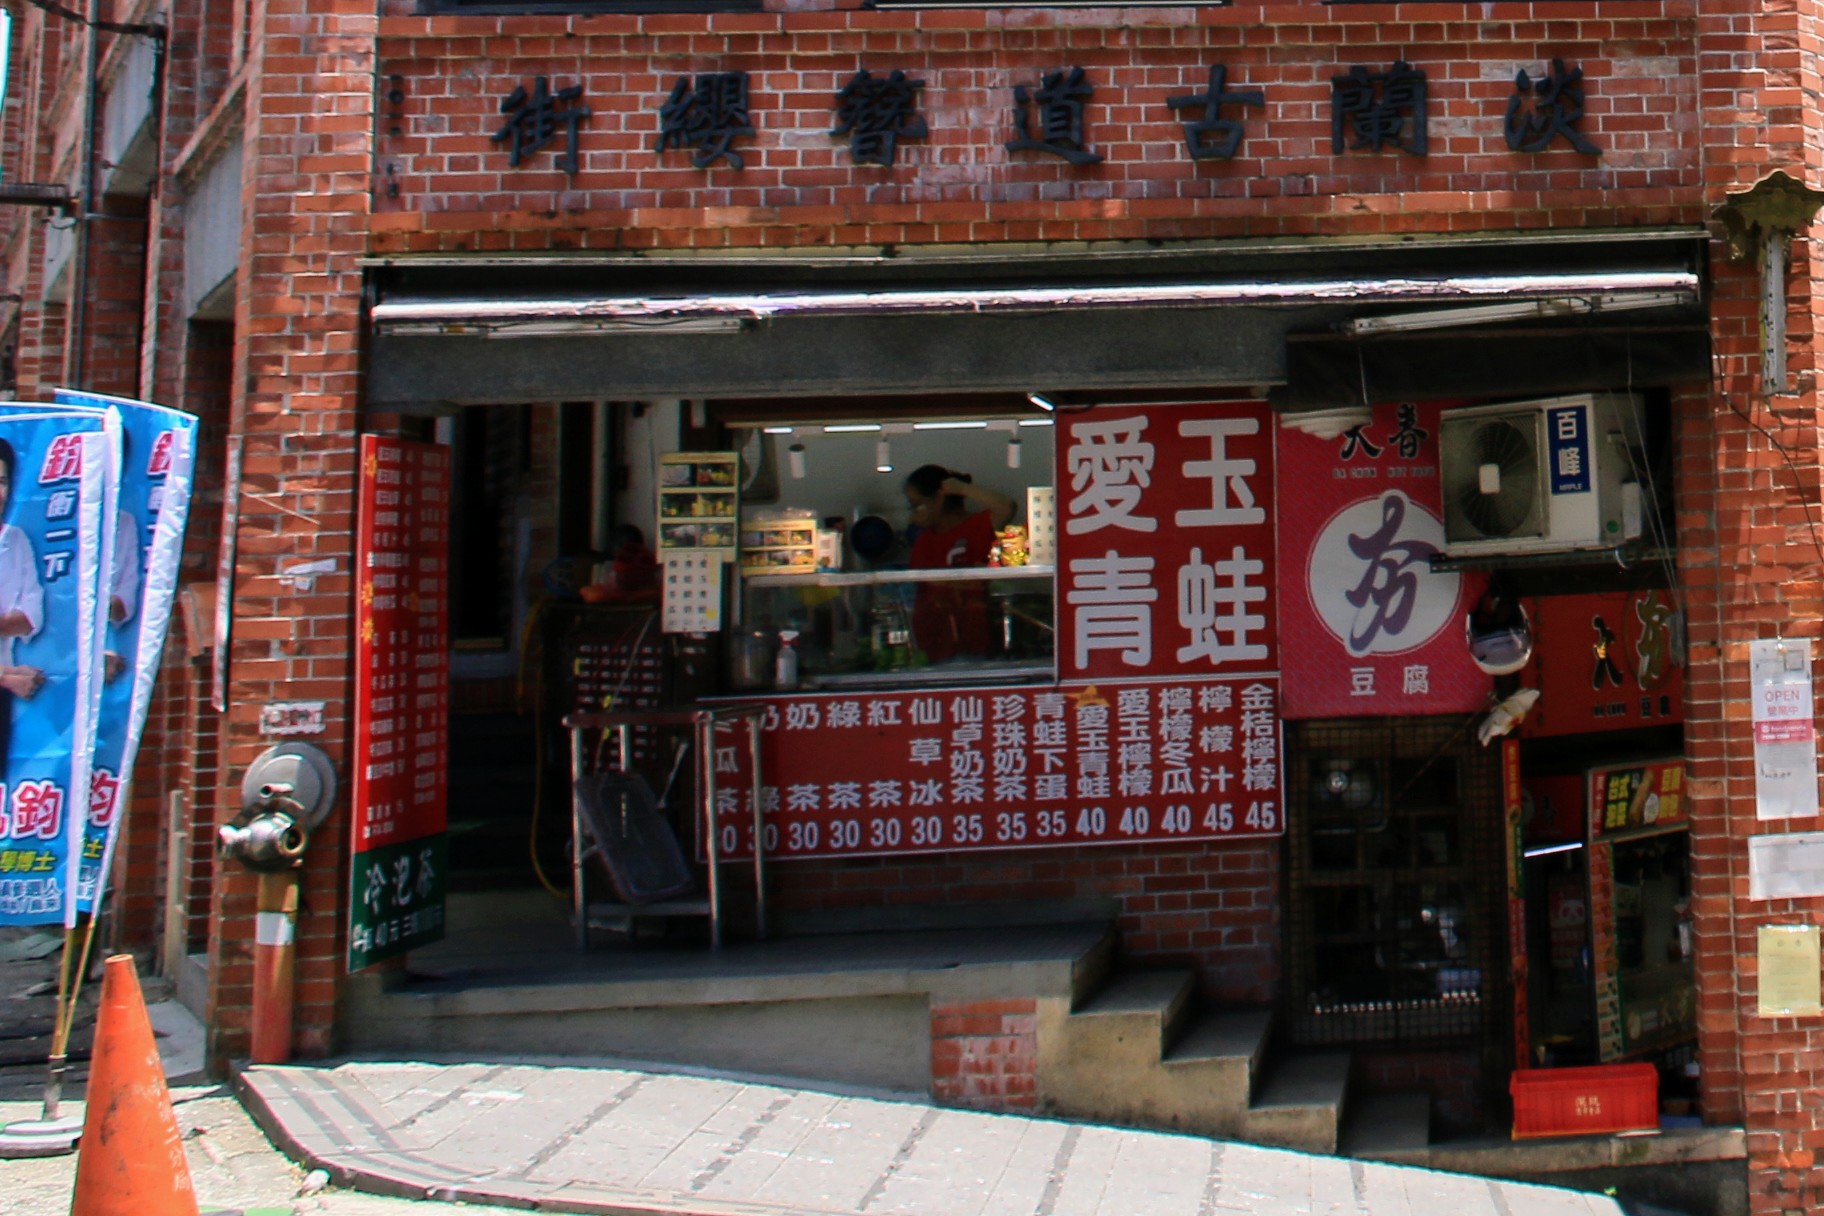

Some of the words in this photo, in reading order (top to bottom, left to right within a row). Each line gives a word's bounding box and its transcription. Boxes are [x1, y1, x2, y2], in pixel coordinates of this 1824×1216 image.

[1066, 414, 1266, 535] 愛玉
[1066, 545, 1269, 670] 青蛙
[1349, 663, 1430, 697] 豆腐
[1764, 689, 1801, 703] OPEN
[786, 702, 821, 813] 奶茶
[826, 700, 862, 810] 綠茶
[867, 699, 903, 808] 紅茶
[908, 697, 943, 807] 仙草冰
[991, 693, 1028, 802] 珍珠奶茶
[1032, 692, 1068, 801] 青蛙下蛋
[1076, 703, 1111, 799] 愛玉青蛙
[1117, 688, 1153, 797] 愛玉檸檬
[1157, 686, 1195, 795] 檸檬冬瓜
[1198, 685, 1235, 794] 檸檬汁
[1240, 682, 1277, 792] 金桔檸檬
[0, 780, 63, 840] 鈞
[870, 817, 902, 847] 30
[911, 815, 943, 845] 30
[953, 813, 984, 843] 35
[996, 811, 1028, 841] 35
[1036, 810, 1067, 837] 35
[1076, 806, 1106, 837] 40
[1119, 806, 1150, 835] 40
[1160, 804, 1192, 834] 40
[1203, 802, 1234, 831] 45
[1245, 800, 1276, 830] 45
[788, 821, 820, 851] 30
[829, 819, 861, 849] 30
